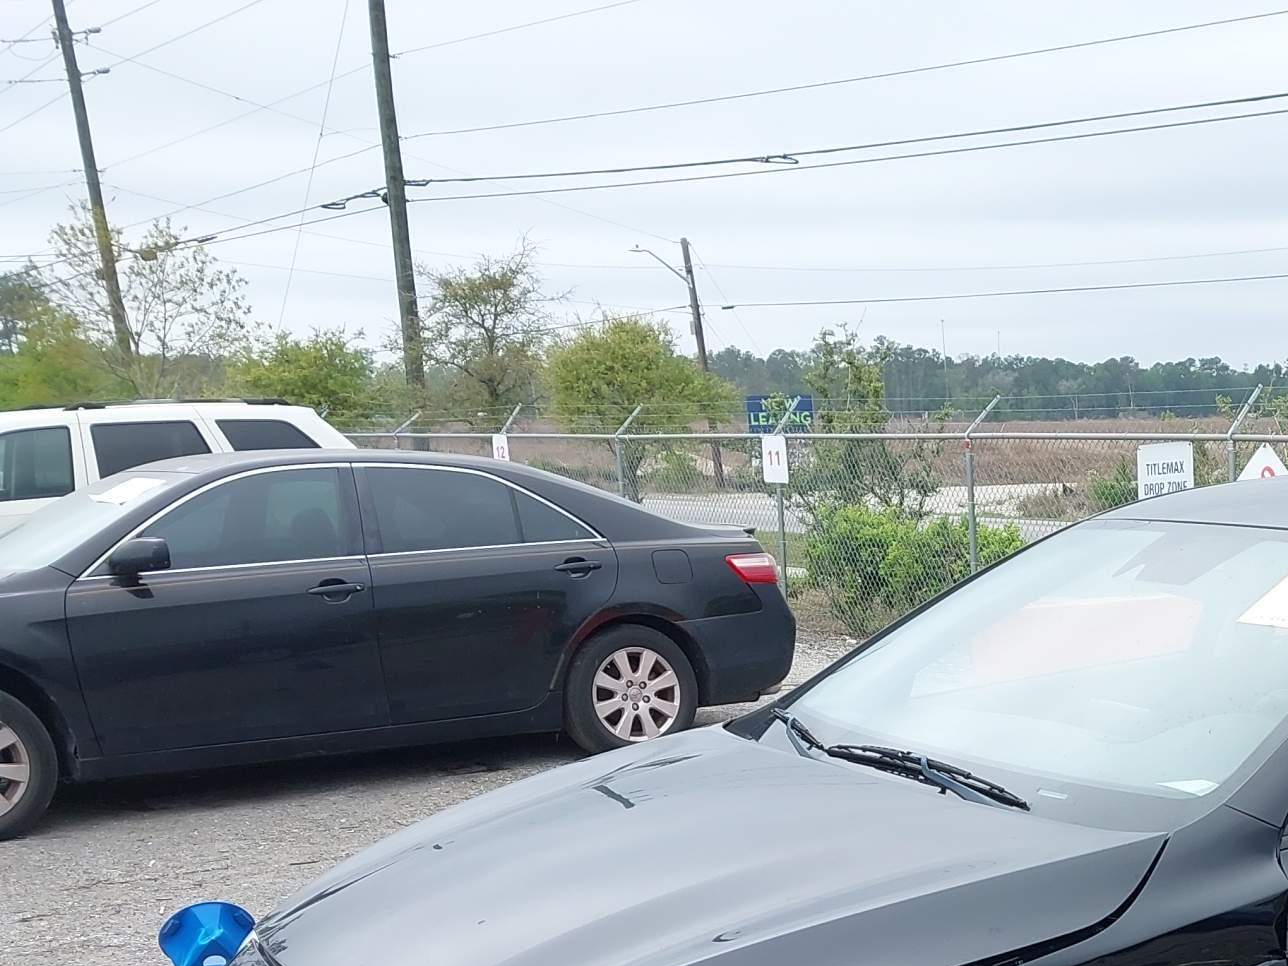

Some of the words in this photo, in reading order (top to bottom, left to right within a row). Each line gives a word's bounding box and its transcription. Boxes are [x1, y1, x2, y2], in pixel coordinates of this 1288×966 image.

[496, 446, 506, 459] 12
[768, 450, 781, 466] 11
[1145, 460, 1185, 476] TITLEMAX
[1143, 482, 1165, 496] DROP
